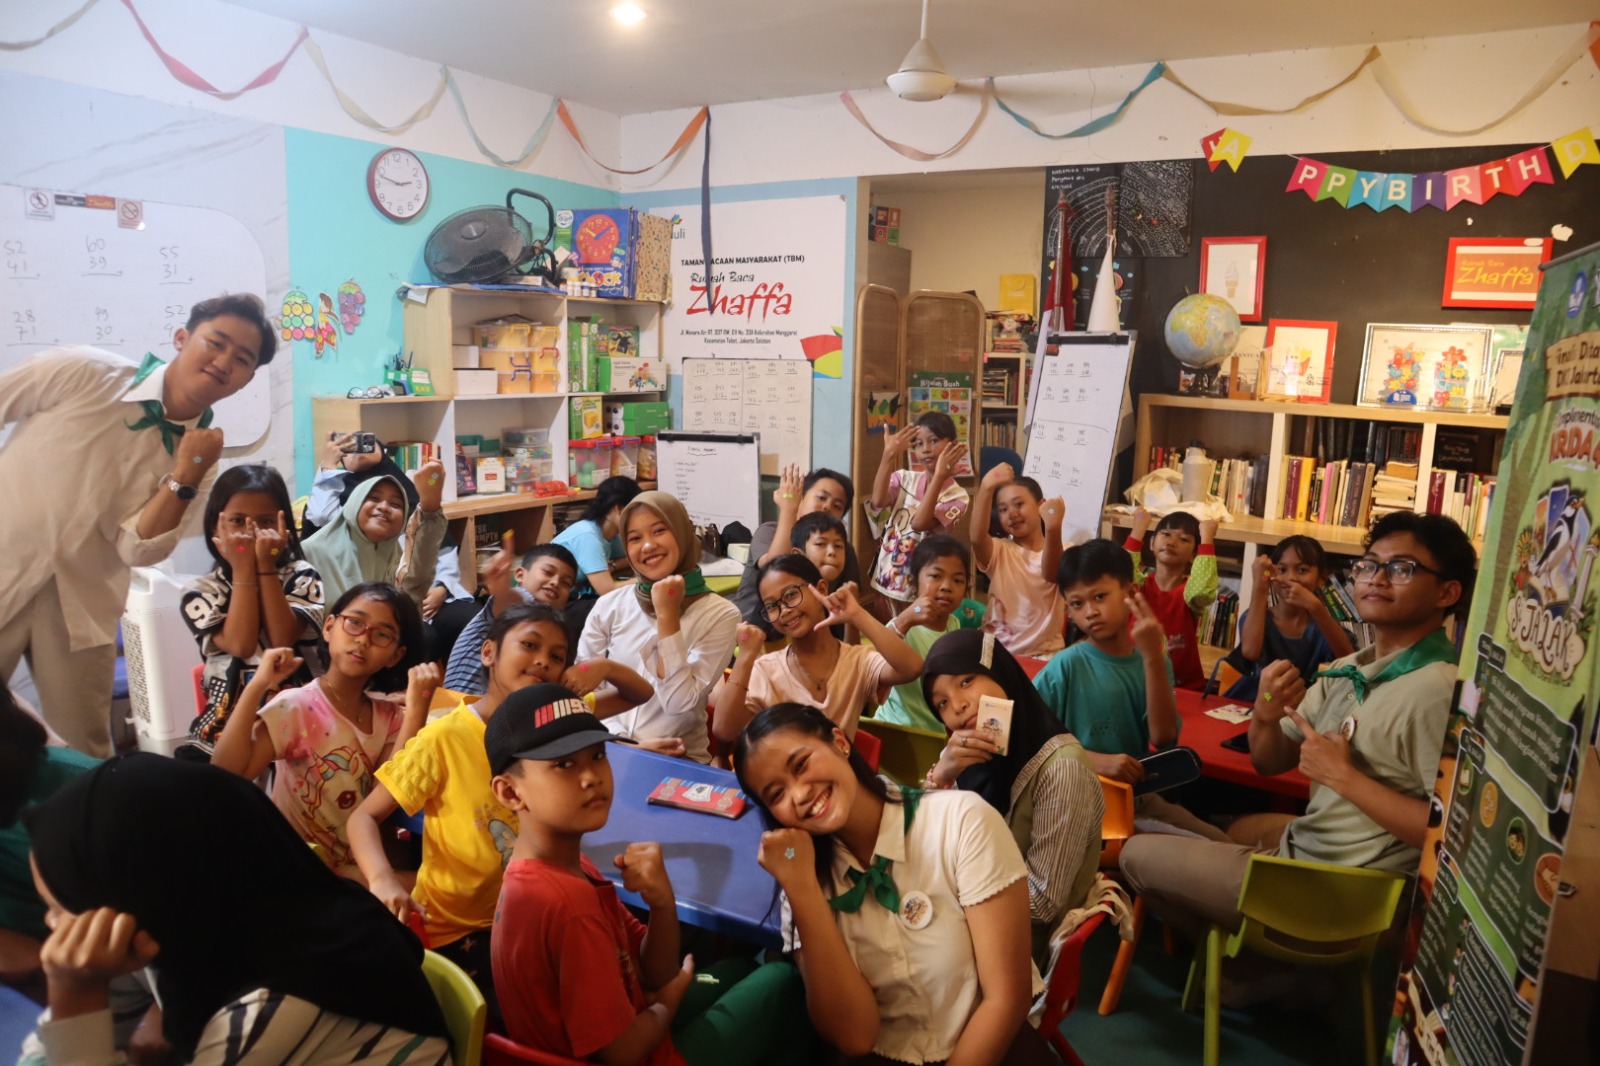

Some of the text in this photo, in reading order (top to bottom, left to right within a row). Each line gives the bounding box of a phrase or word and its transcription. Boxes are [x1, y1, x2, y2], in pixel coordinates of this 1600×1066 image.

[393, 153, 401, 163] 12
[412, 167, 419, 178] 2
[416, 180, 423, 190] 3
[414, 193, 420, 202] 4
[407, 201, 414, 211] 5
[708, 257, 734, 265] ACAAN
[735, 255, 782, 264] MASYARAKAT
[783, 254, 805, 264] (TBM)
[729, 271, 755, 282] Baca
[1456, 266, 1535, 290] Zhaffa
[686, 282, 793, 324] Zhaffa
